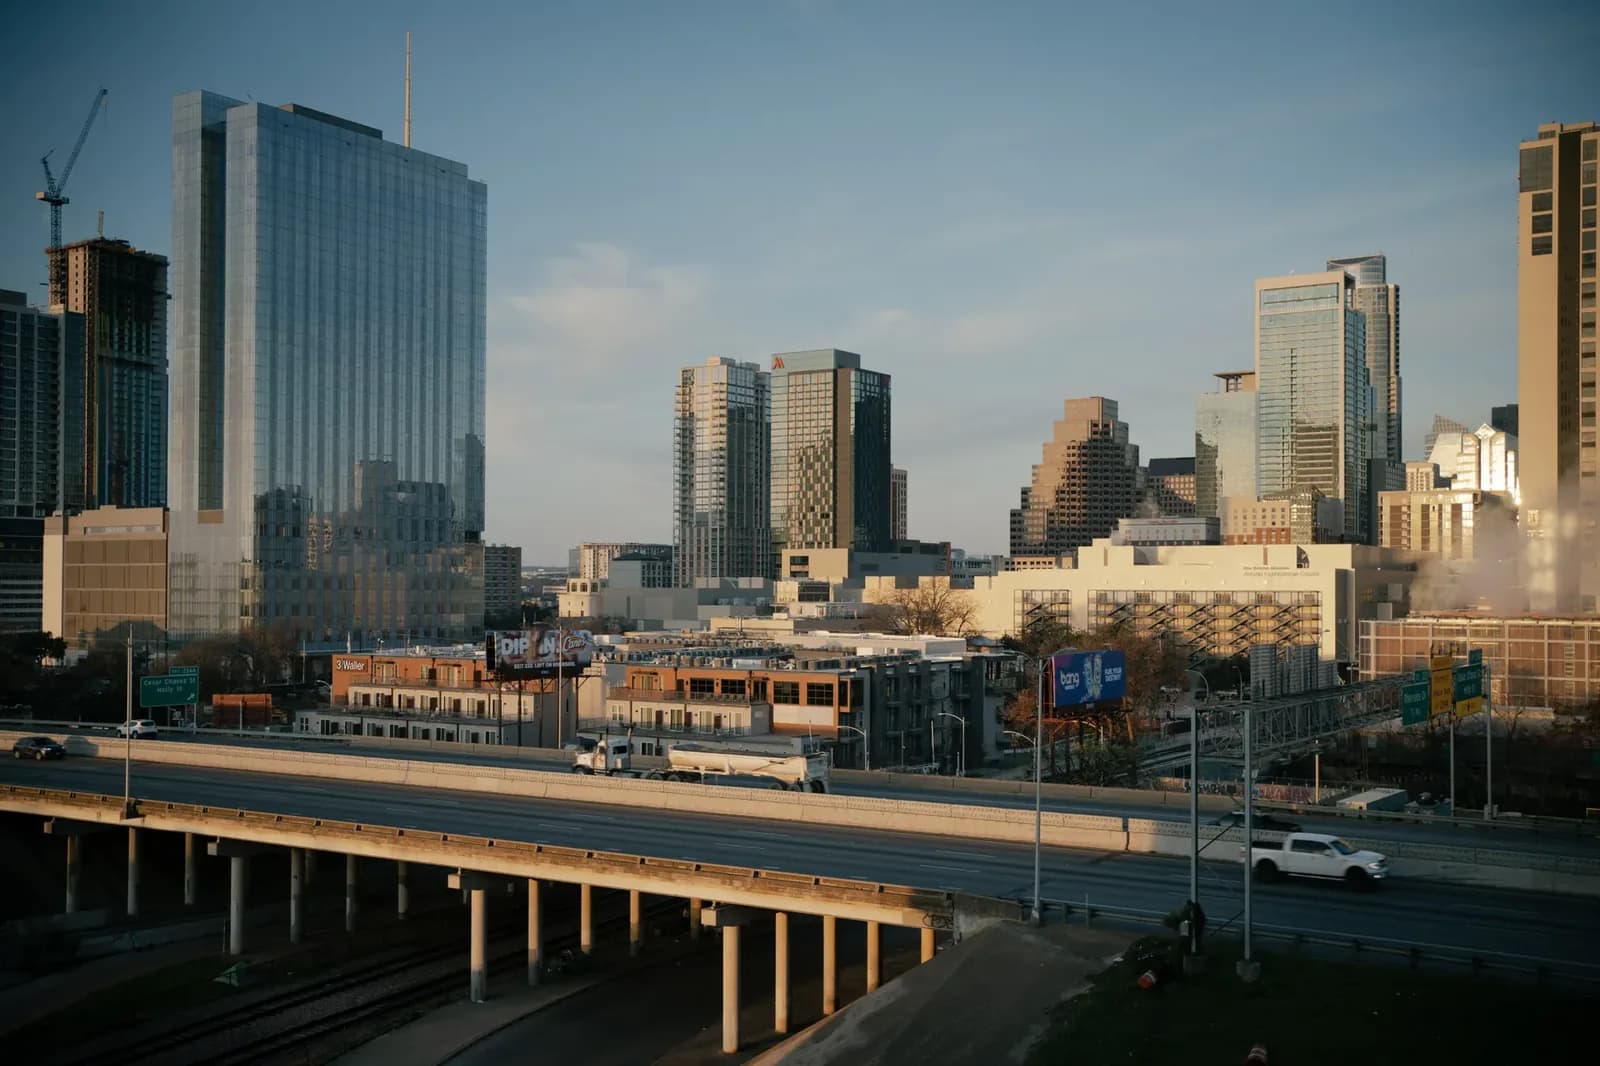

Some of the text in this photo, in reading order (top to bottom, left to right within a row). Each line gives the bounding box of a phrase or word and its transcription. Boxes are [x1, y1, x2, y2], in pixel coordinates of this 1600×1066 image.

[501, 638, 529, 655] DIP
[336, 659, 365, 670] 3 Waller
[1060, 670, 1080, 688] bang
